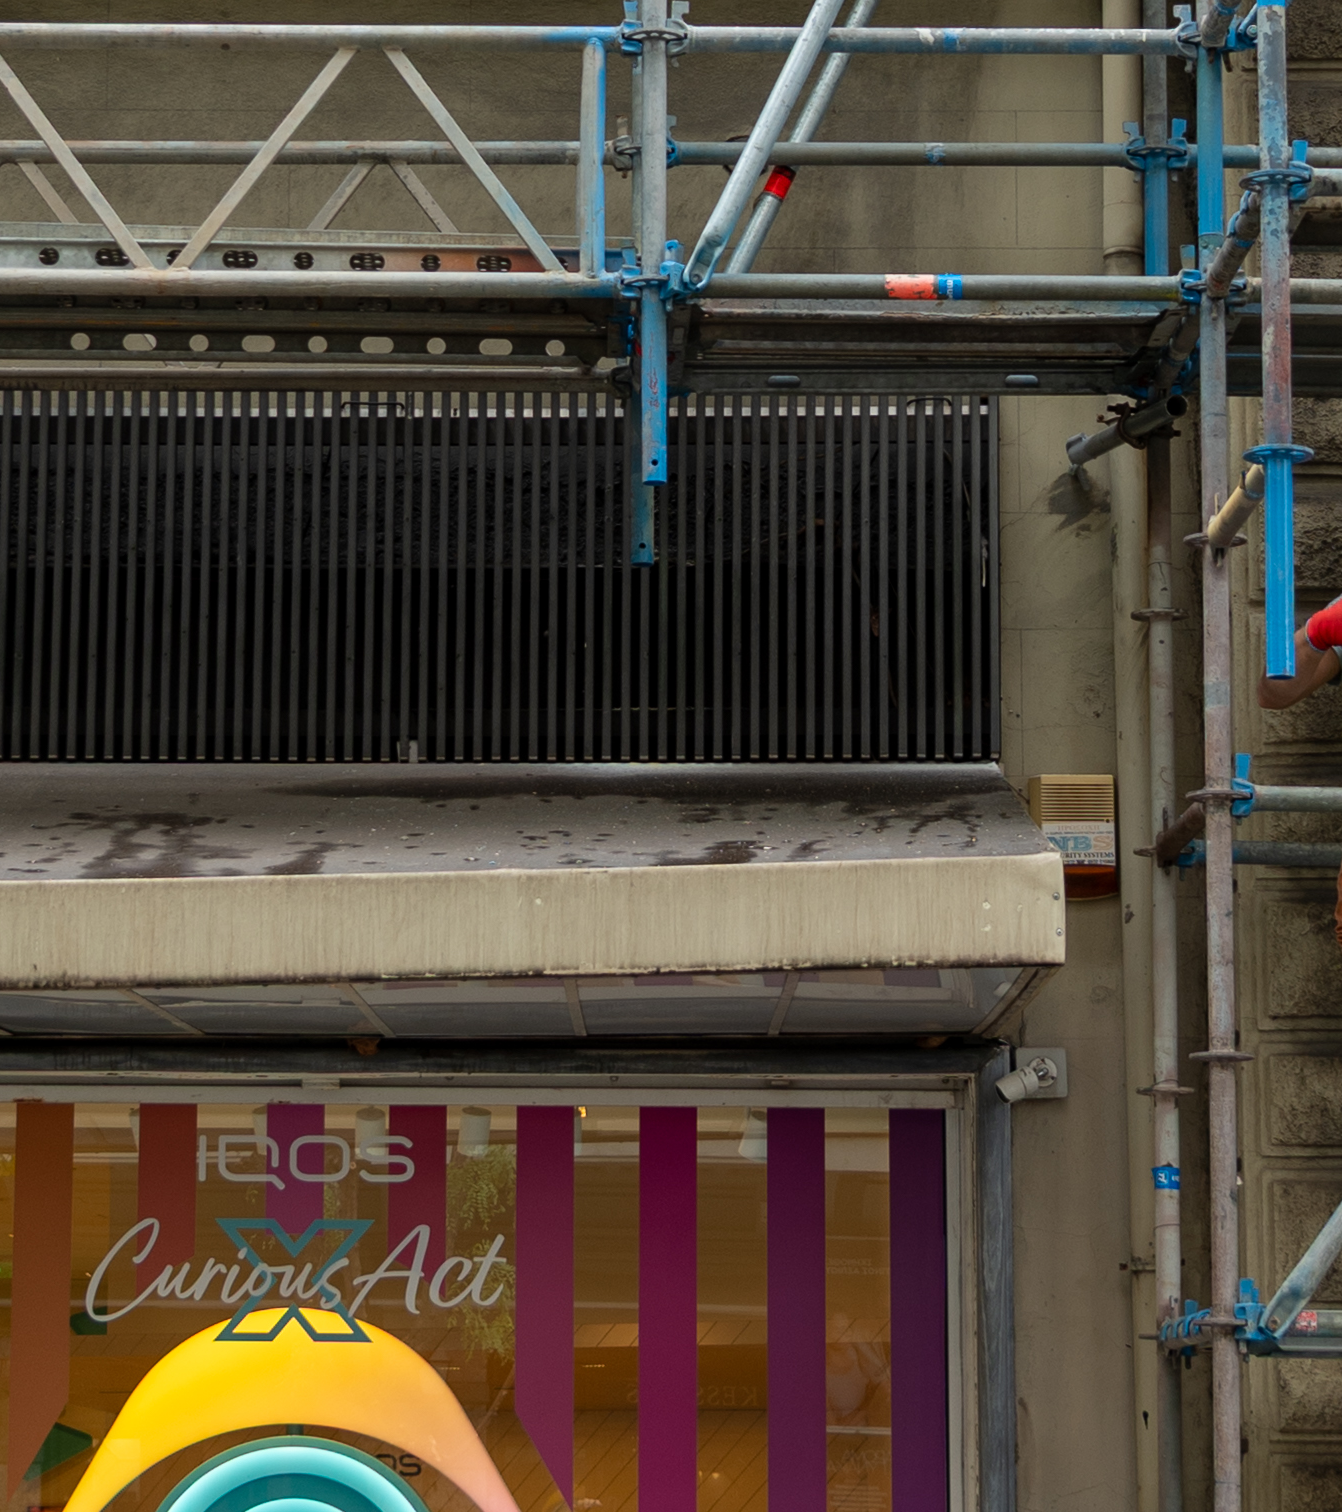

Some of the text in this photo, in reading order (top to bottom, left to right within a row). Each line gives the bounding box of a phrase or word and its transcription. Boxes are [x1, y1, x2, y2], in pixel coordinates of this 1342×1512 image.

[198, 1134, 416, 1190] IQOS
[84, 1217, 350, 1323] Curious
[347, 1224, 507, 1319] Act
